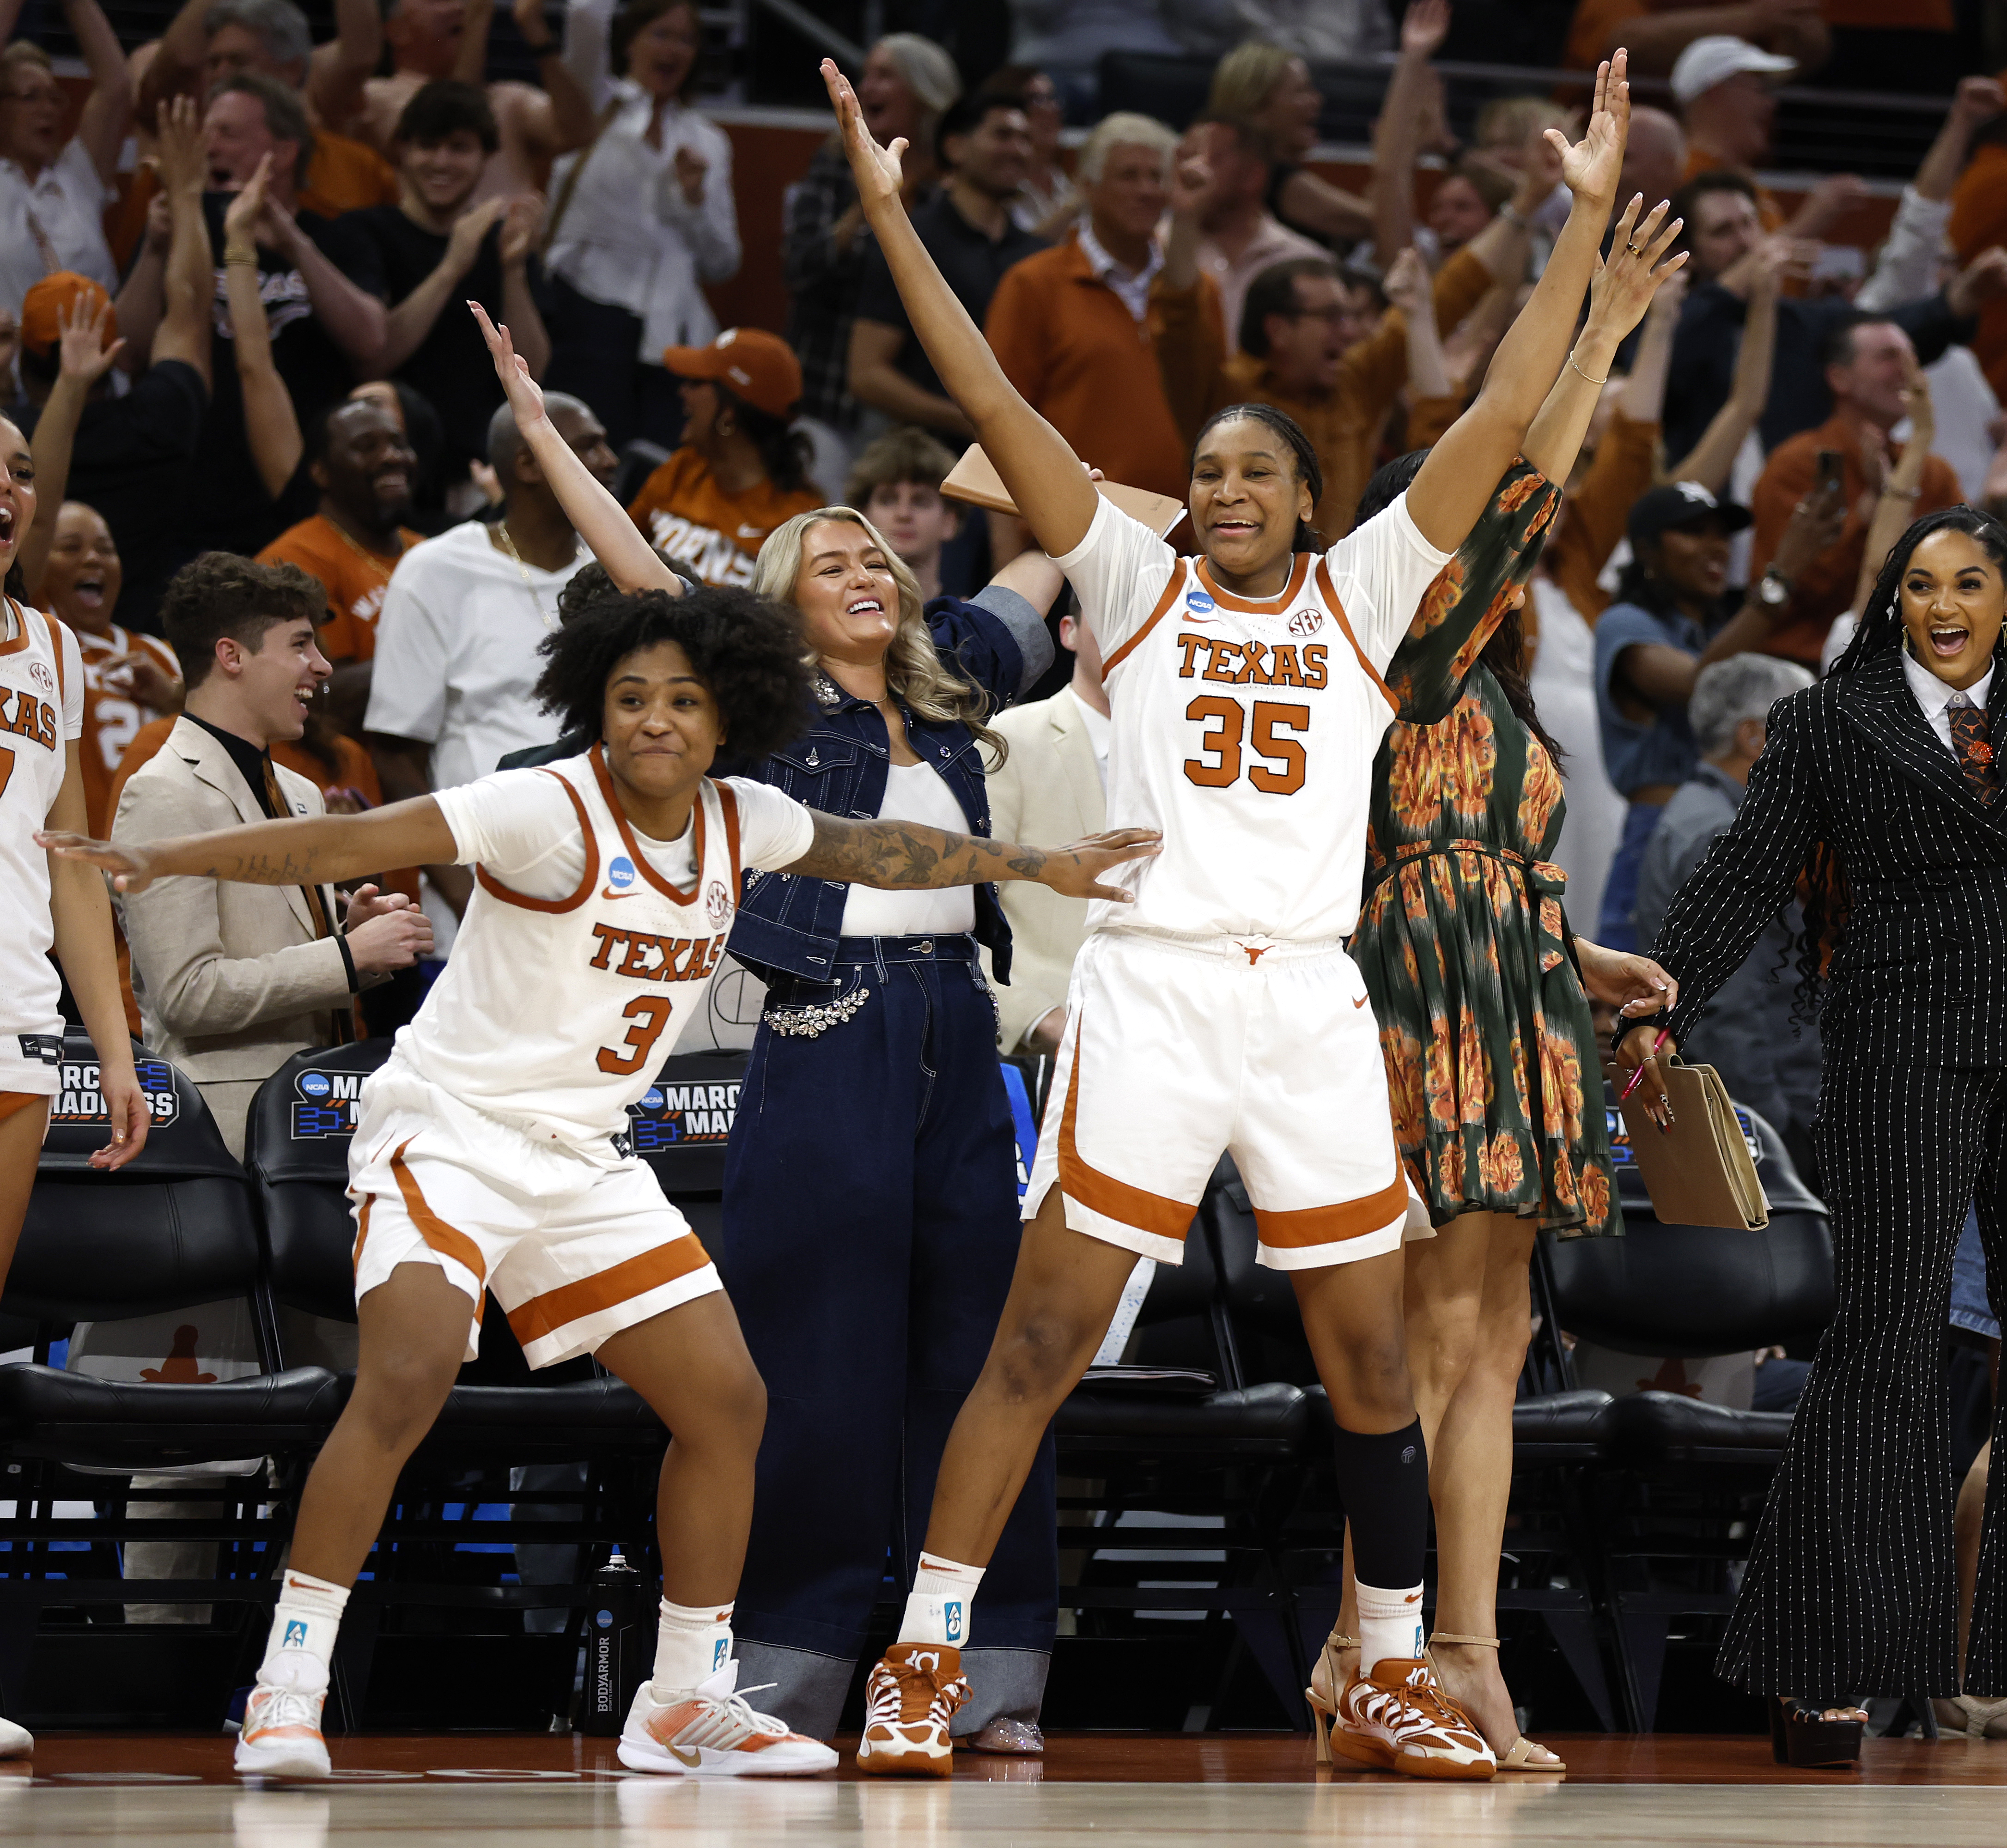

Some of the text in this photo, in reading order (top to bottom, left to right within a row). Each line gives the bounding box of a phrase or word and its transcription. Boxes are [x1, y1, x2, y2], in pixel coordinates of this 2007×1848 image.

[1188, 598, 1212, 609] NCAA
[1289, 609, 1322, 636] SEC
[30, 663, 53, 692] SEC
[1177, 633, 1328, 690] TEXAS
[94, 698, 156, 771] 2
[1184, 694, 1310, 796] 35
[707, 881, 726, 917] SEC
[590, 922, 727, 982] TEXAS
[596, 995, 673, 1076] 3
[598, 1637, 609, 1712] BODYARMOR
